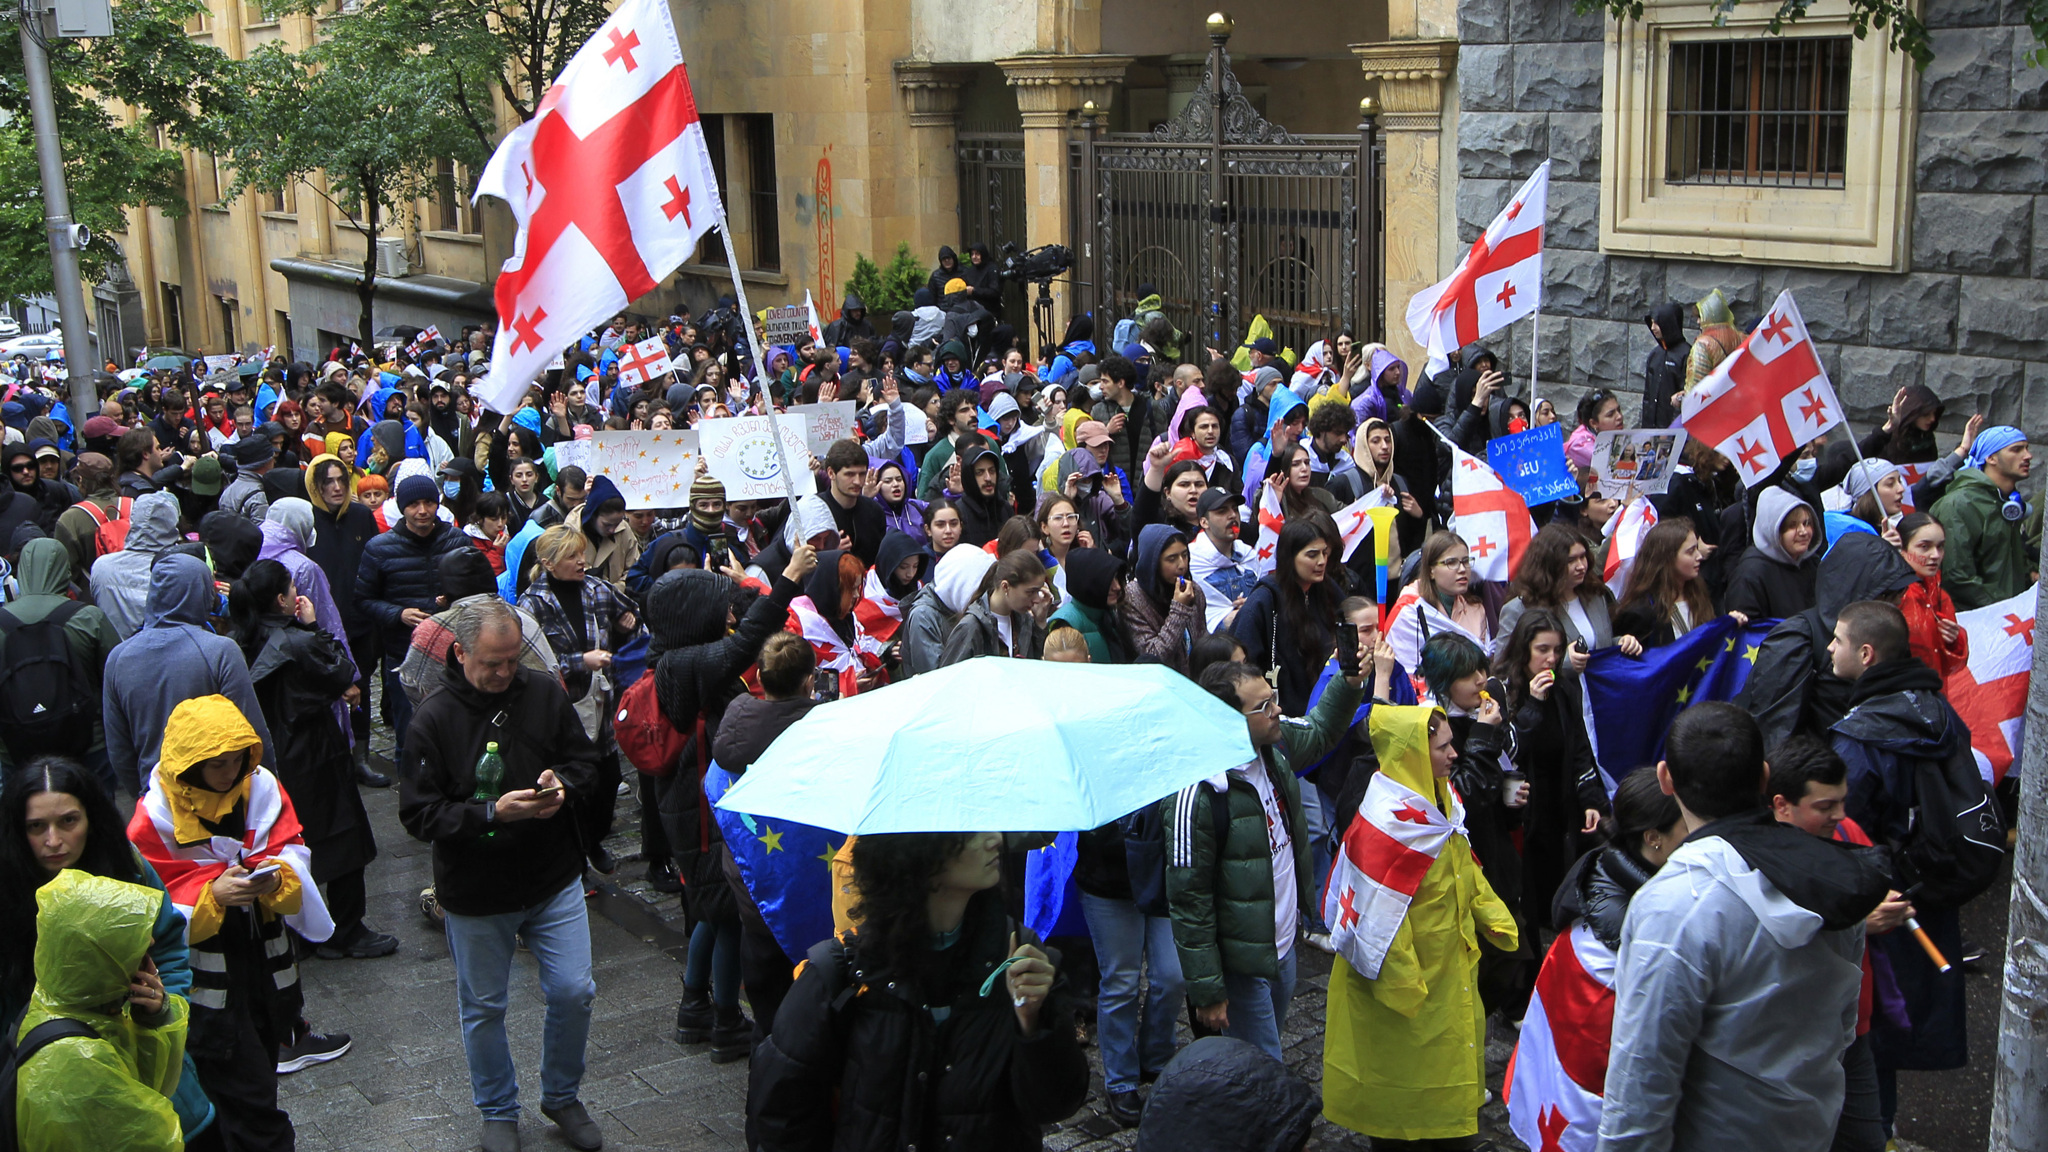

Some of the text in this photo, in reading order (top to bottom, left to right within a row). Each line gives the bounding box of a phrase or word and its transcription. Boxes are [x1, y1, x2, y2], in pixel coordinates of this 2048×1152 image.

[766, 308, 781, 320] LOVE
[776, 321, 790, 331] NEVER
[791, 320, 809, 331] TRUST
